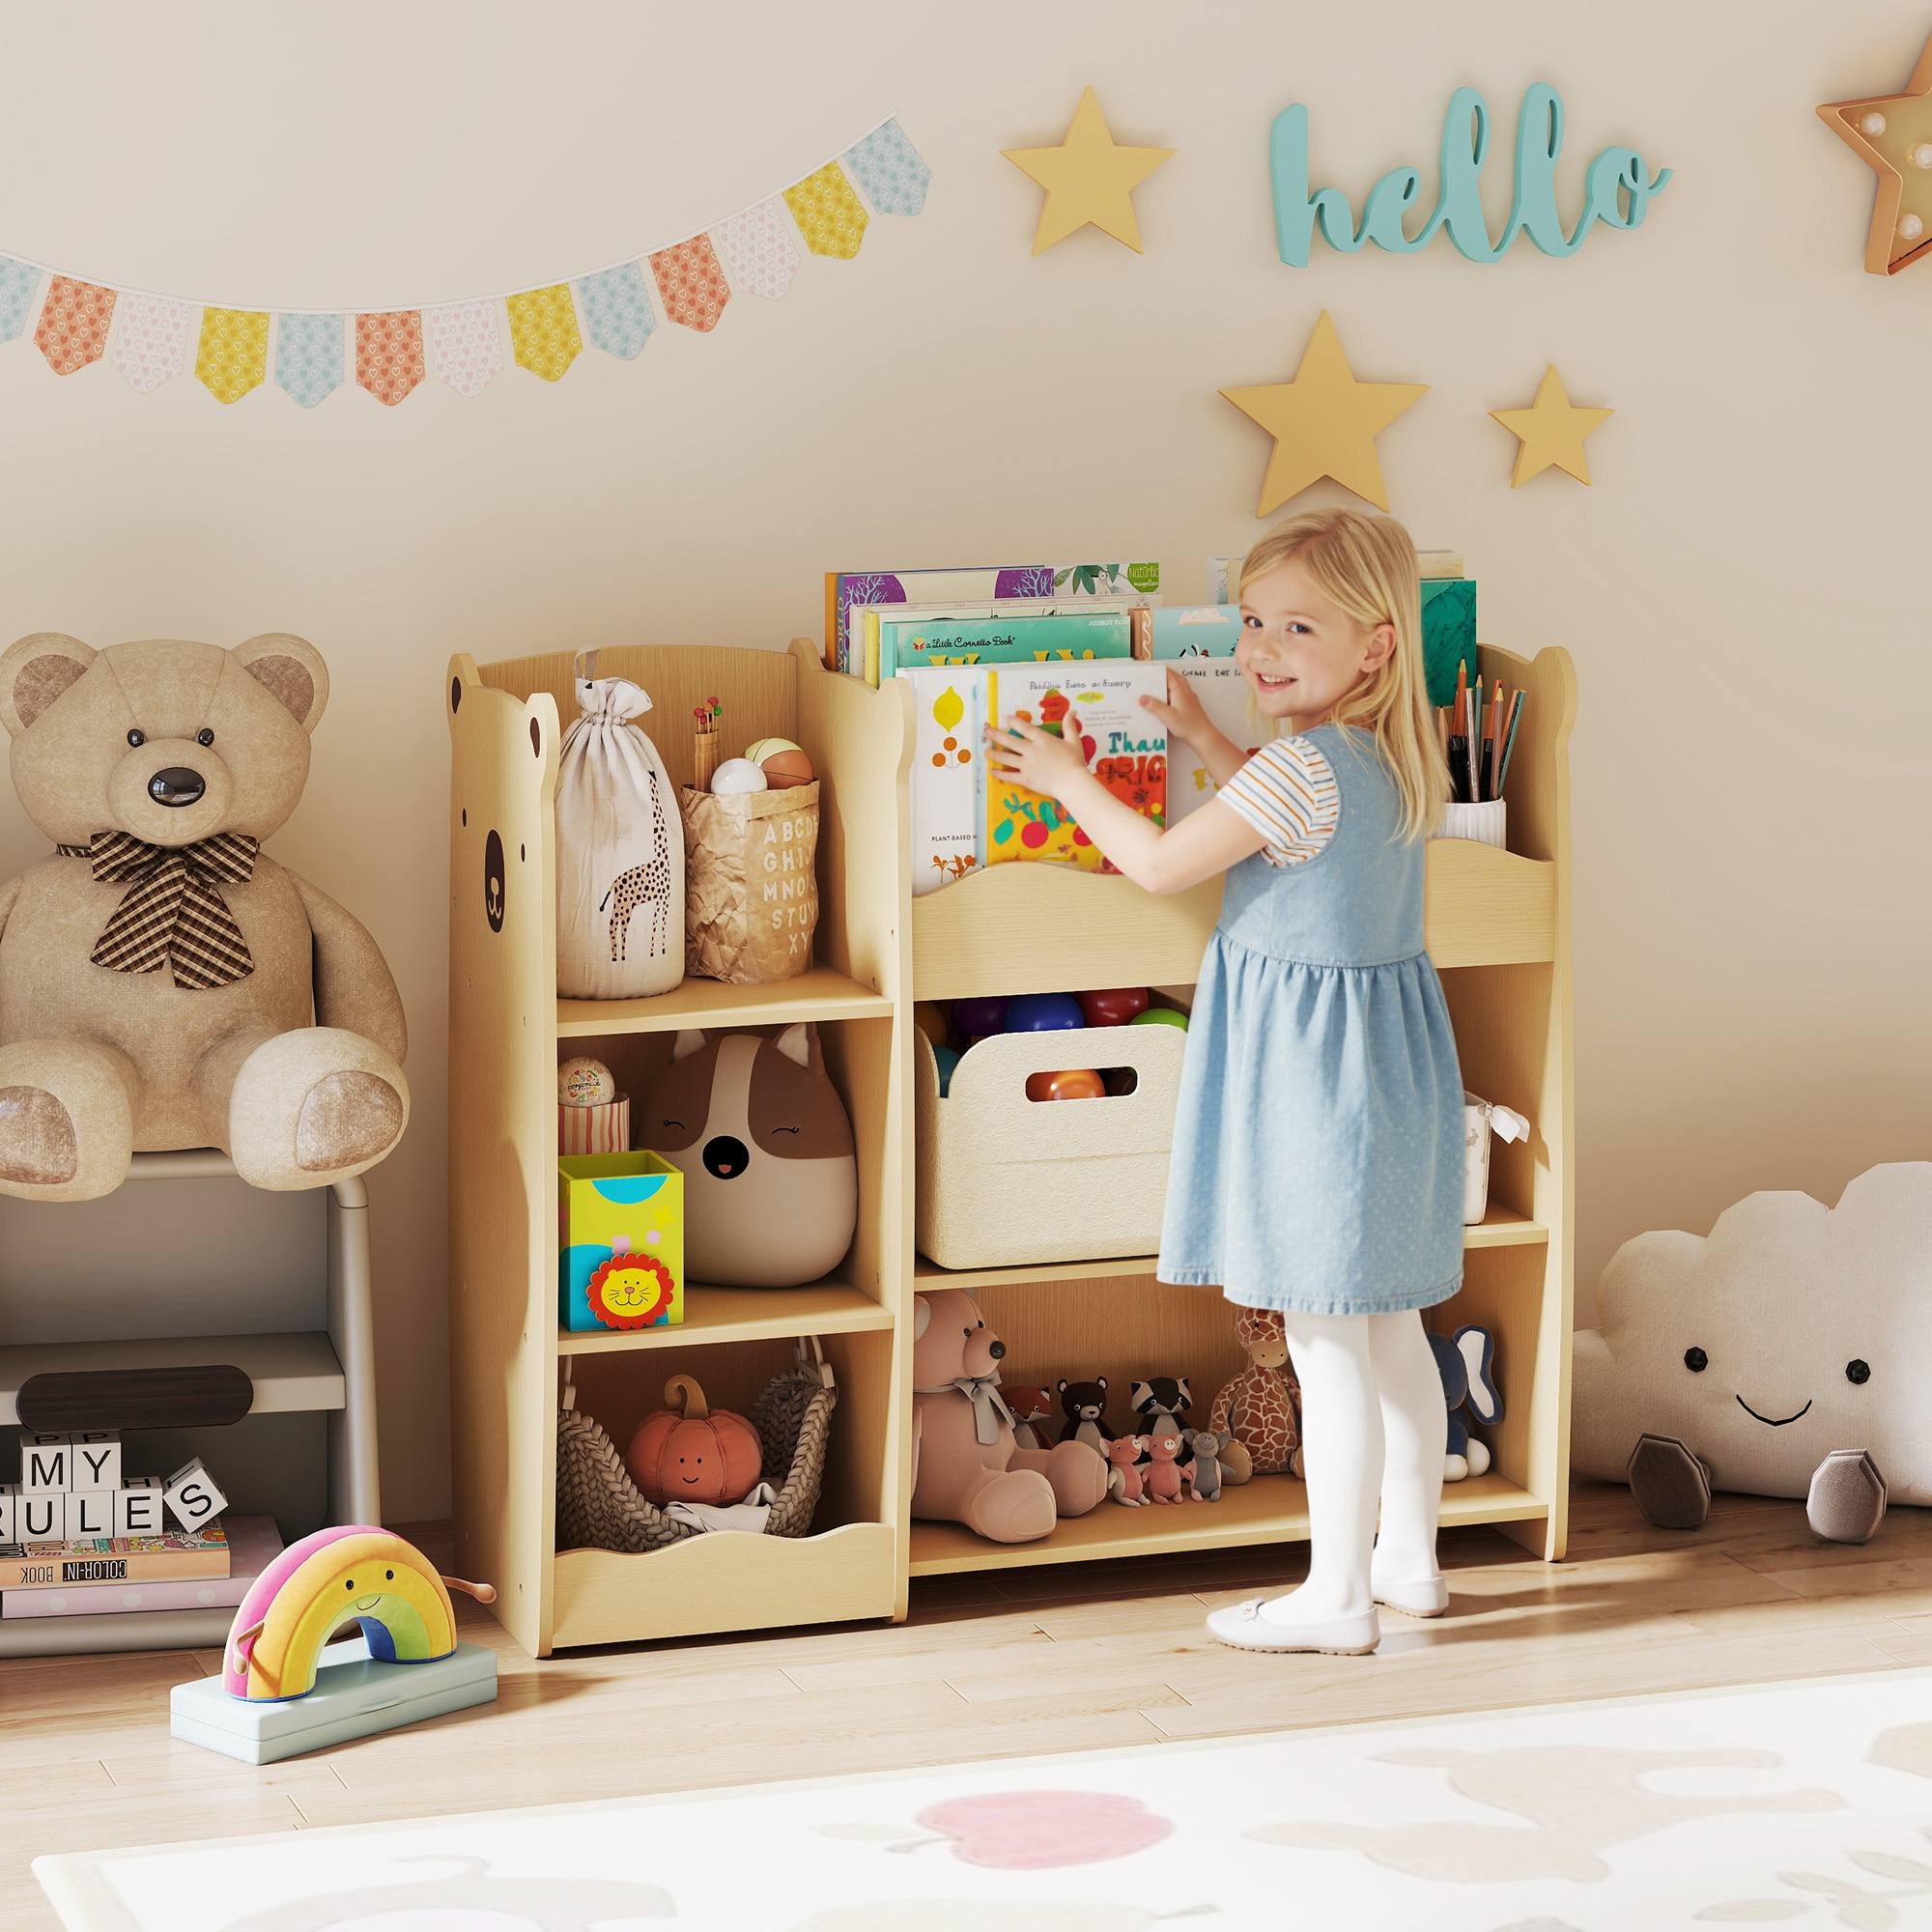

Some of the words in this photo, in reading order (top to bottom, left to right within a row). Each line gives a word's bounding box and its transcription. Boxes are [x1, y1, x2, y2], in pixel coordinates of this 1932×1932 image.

[1269, 82, 1673, 268] hello
[932, 639, 952, 649] Little
[31, 1450, 112, 1487] MY
[0, 1484, 213, 1537] ULES
[20, 1566, 53, 1583] BOOK
